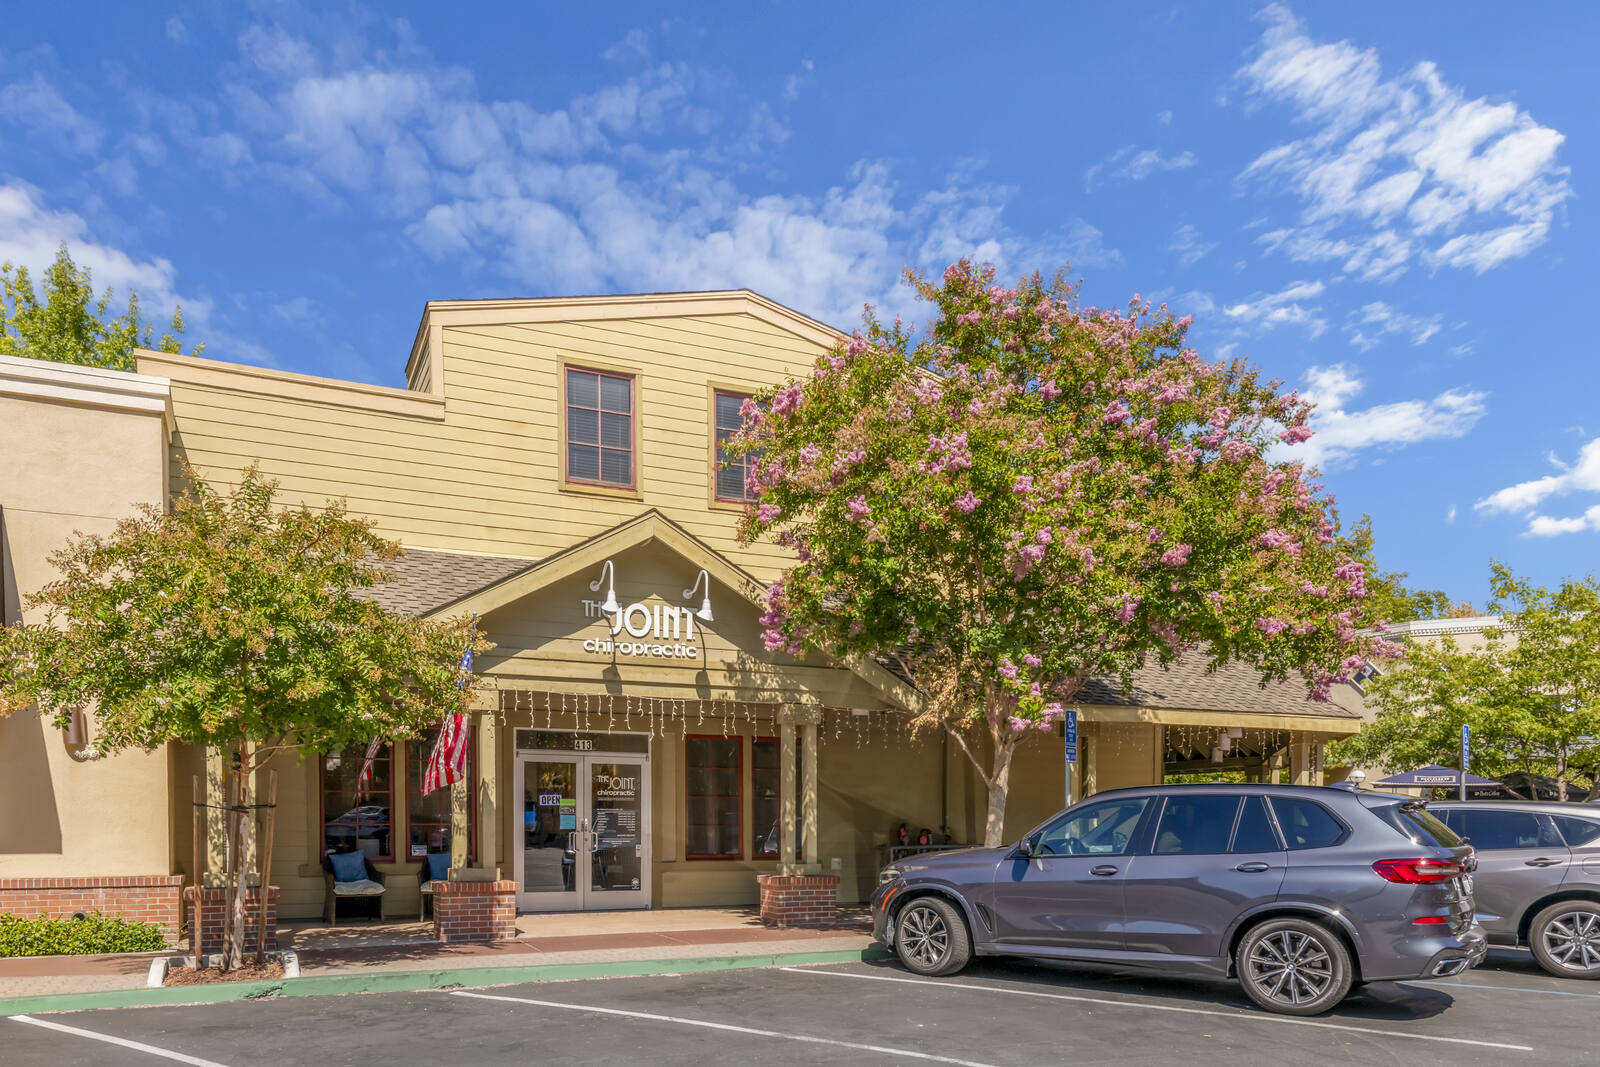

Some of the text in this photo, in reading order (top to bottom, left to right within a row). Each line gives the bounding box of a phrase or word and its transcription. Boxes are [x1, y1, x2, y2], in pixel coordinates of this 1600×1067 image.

[581, 600, 698, 640] TH JOINT
[583, 637, 697, 657] chiropractic
[575, 740, 592, 750] 413
[607, 776, 635, 790] JOINT
[541, 795, 560, 805] OPEN
